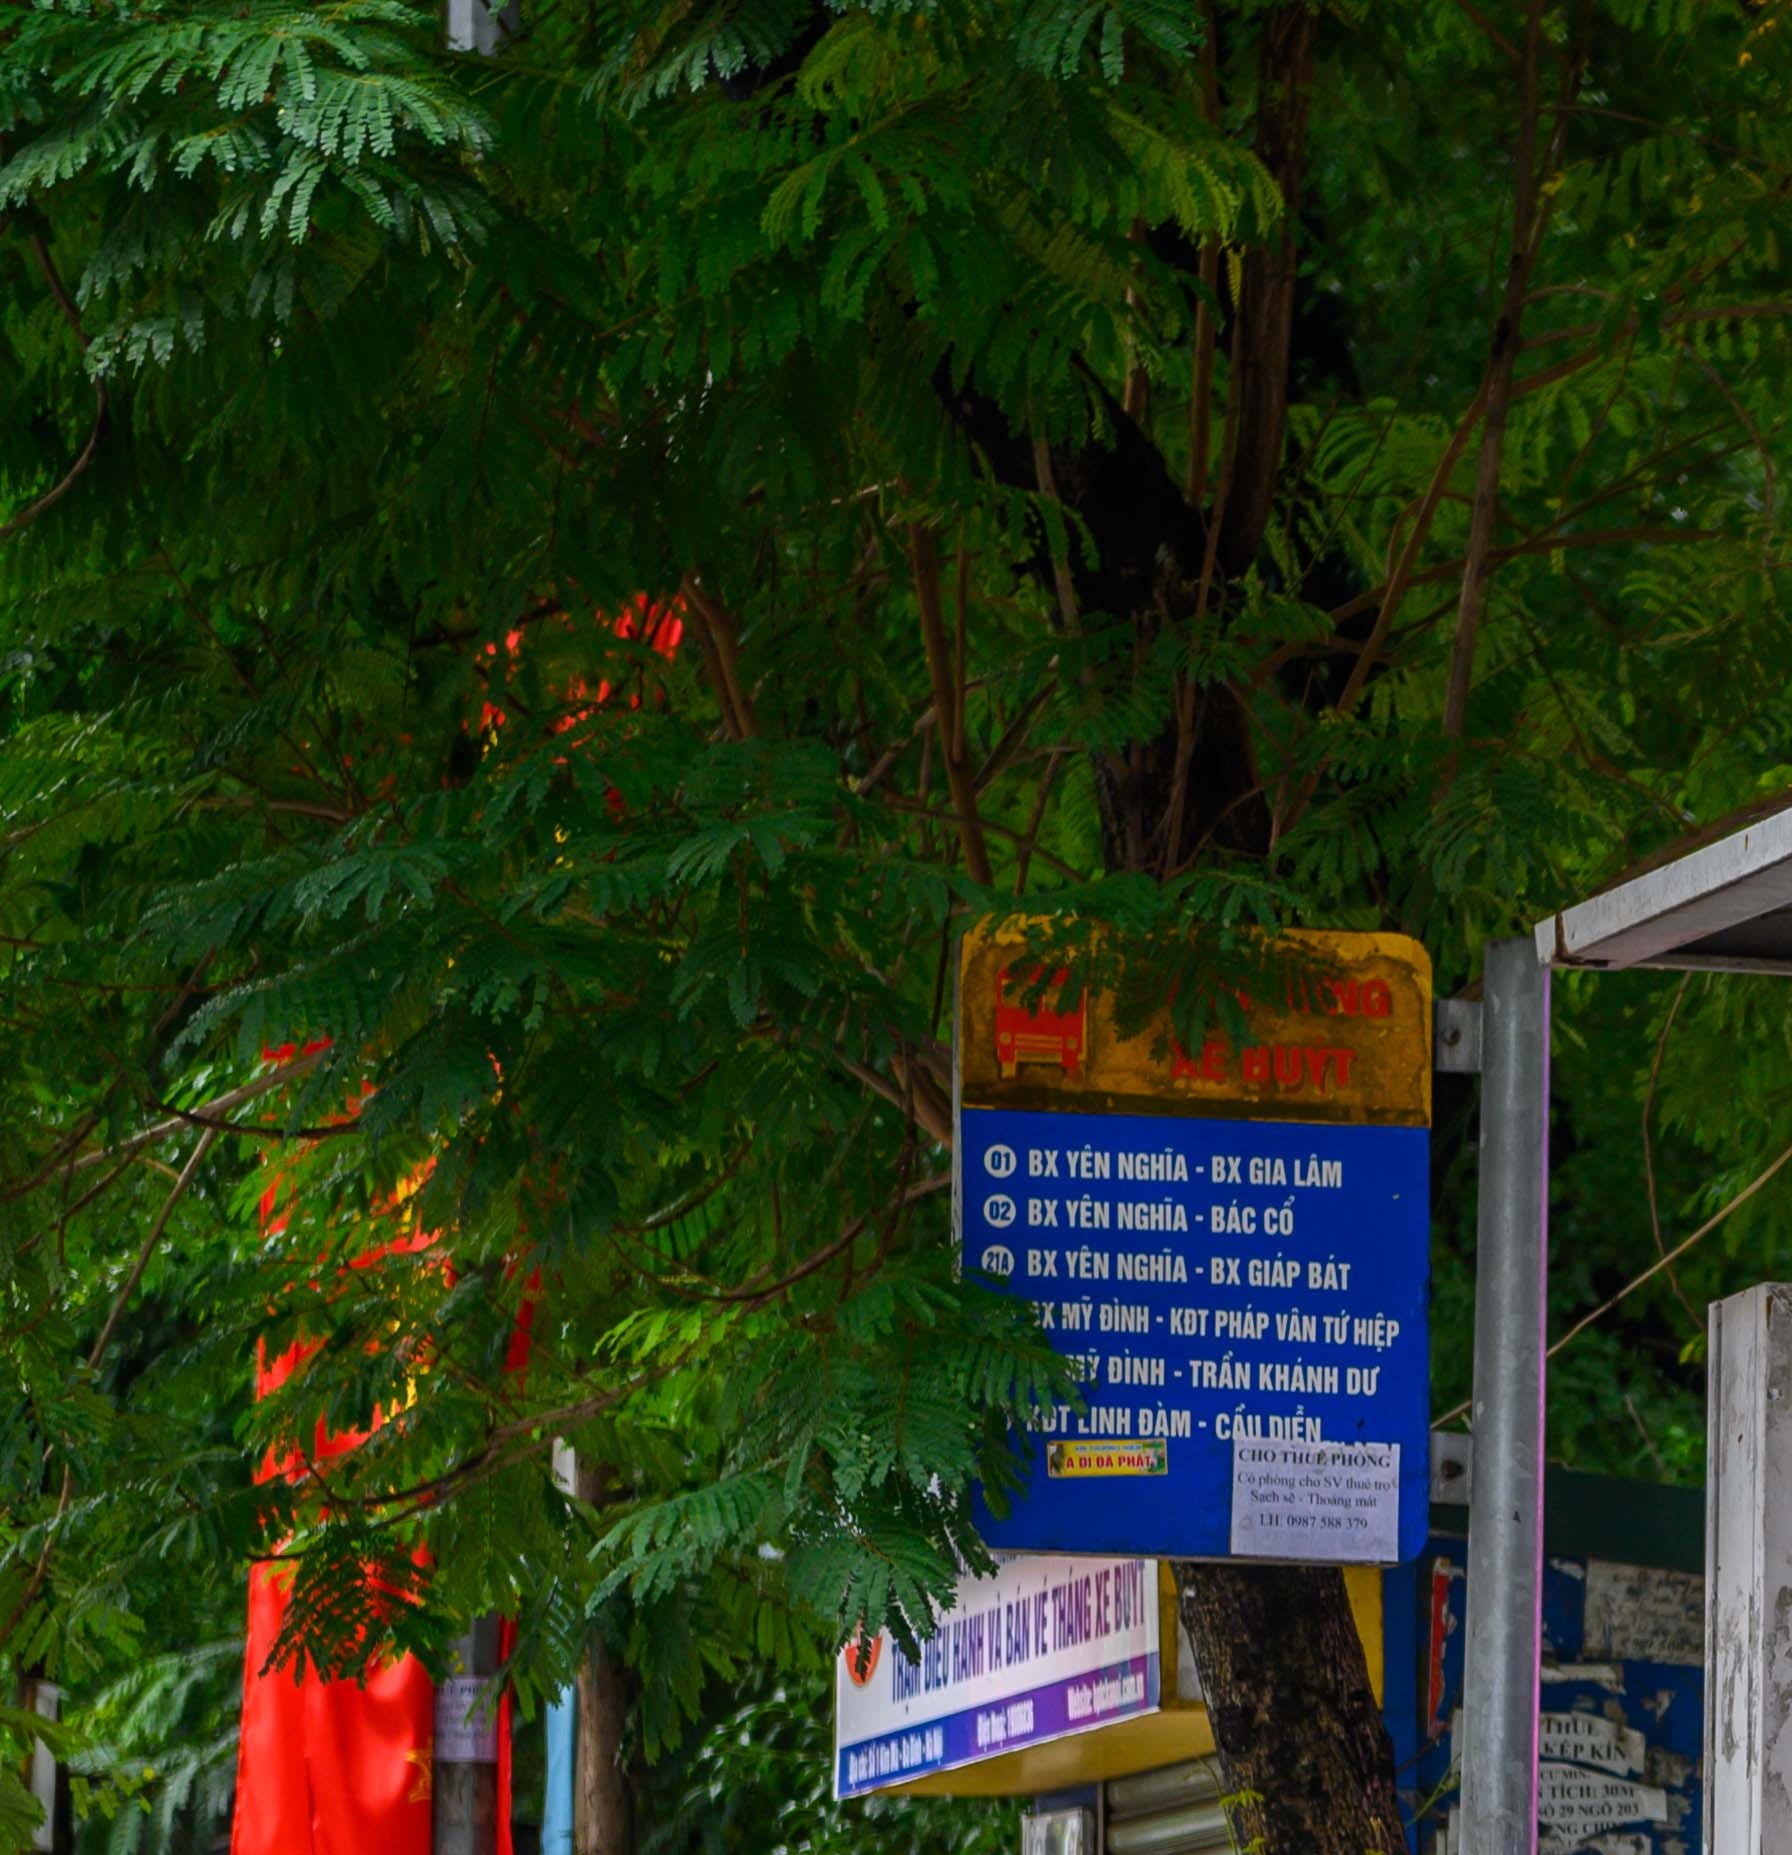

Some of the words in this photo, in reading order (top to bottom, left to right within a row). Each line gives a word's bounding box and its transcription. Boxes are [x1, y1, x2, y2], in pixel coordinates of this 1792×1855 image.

[1029, 1149, 1058, 1177] BX
[1067, 1145, 1110, 1180] YÊN
[1118, 1147, 1188, 1182] NGHĨA
[1211, 1156, 1241, 1184] BX
[1249, 1158, 1287, 1187] GIA
[1294, 1154, 1342, 1189] LÂM
[1028, 1199, 1058, 1227] BX
[1067, 1194, 1110, 1229] YÊN
[1117, 1196, 1188, 1232] NGHĨA
[1211, 1199, 1256, 1234] BÁC
[1264, 1194, 1295, 1236] CỔ
[1027, 1249, 1057, 1277] BX
[1066, 1245, 1109, 1280] YÊN
[1117, 1247, 1188, 1282] NGHĨA
[1210, 1258, 1241, 1286] BX
[1248, 1253, 1300, 1289] GIÁP
[1308, 1254, 1350, 1291] BÁT
[1062, 1296, 1093, 1331] MỸ
[1099, 1299, 1149, 1334] ĐÌNH
[1170, 1308, 1207, 1338] KĐT
[1214, 1304, 1270, 1340] PHÁP
[1276, 1306, 1316, 1343] VÂN
[1322, 1306, 1350, 1343] TỨ
[1354, 1312, 1400, 1354] HIỆP
[1108, 1350, 1164, 1386] ĐÌNH
[1190, 1351, 1251, 1390] TRẦN
[1259, 1353, 1338, 1395] KHÁNH
[1347, 1364, 1381, 1396] DƯ
[1078, 1407, 1131, 1436] LINH
[1138, 1401, 1191, 1438] ĐÀM
[1215, 1402, 1262, 1442] CẦU
[1269, 1404, 1322, 1442] DIỄN
[1239, 1449, 1277, 1463] CHO
[1281, 1446, 1328, 1465] THUÊ
[1331, 1450, 1391, 1468] PHÒNG
[1299, 1475, 1321, 1488] cho
[1323, 1476, 1343, 1489] SV
[988, 1592, 1001, 1673] VÀ
[1006, 1584, 1031, 1667] BÁN
[1034, 1574, 1048, 1658] VÉ
[1052, 1565, 1091, 1652] THÁNG
[1095, 1569, 1110, 1639] XE
